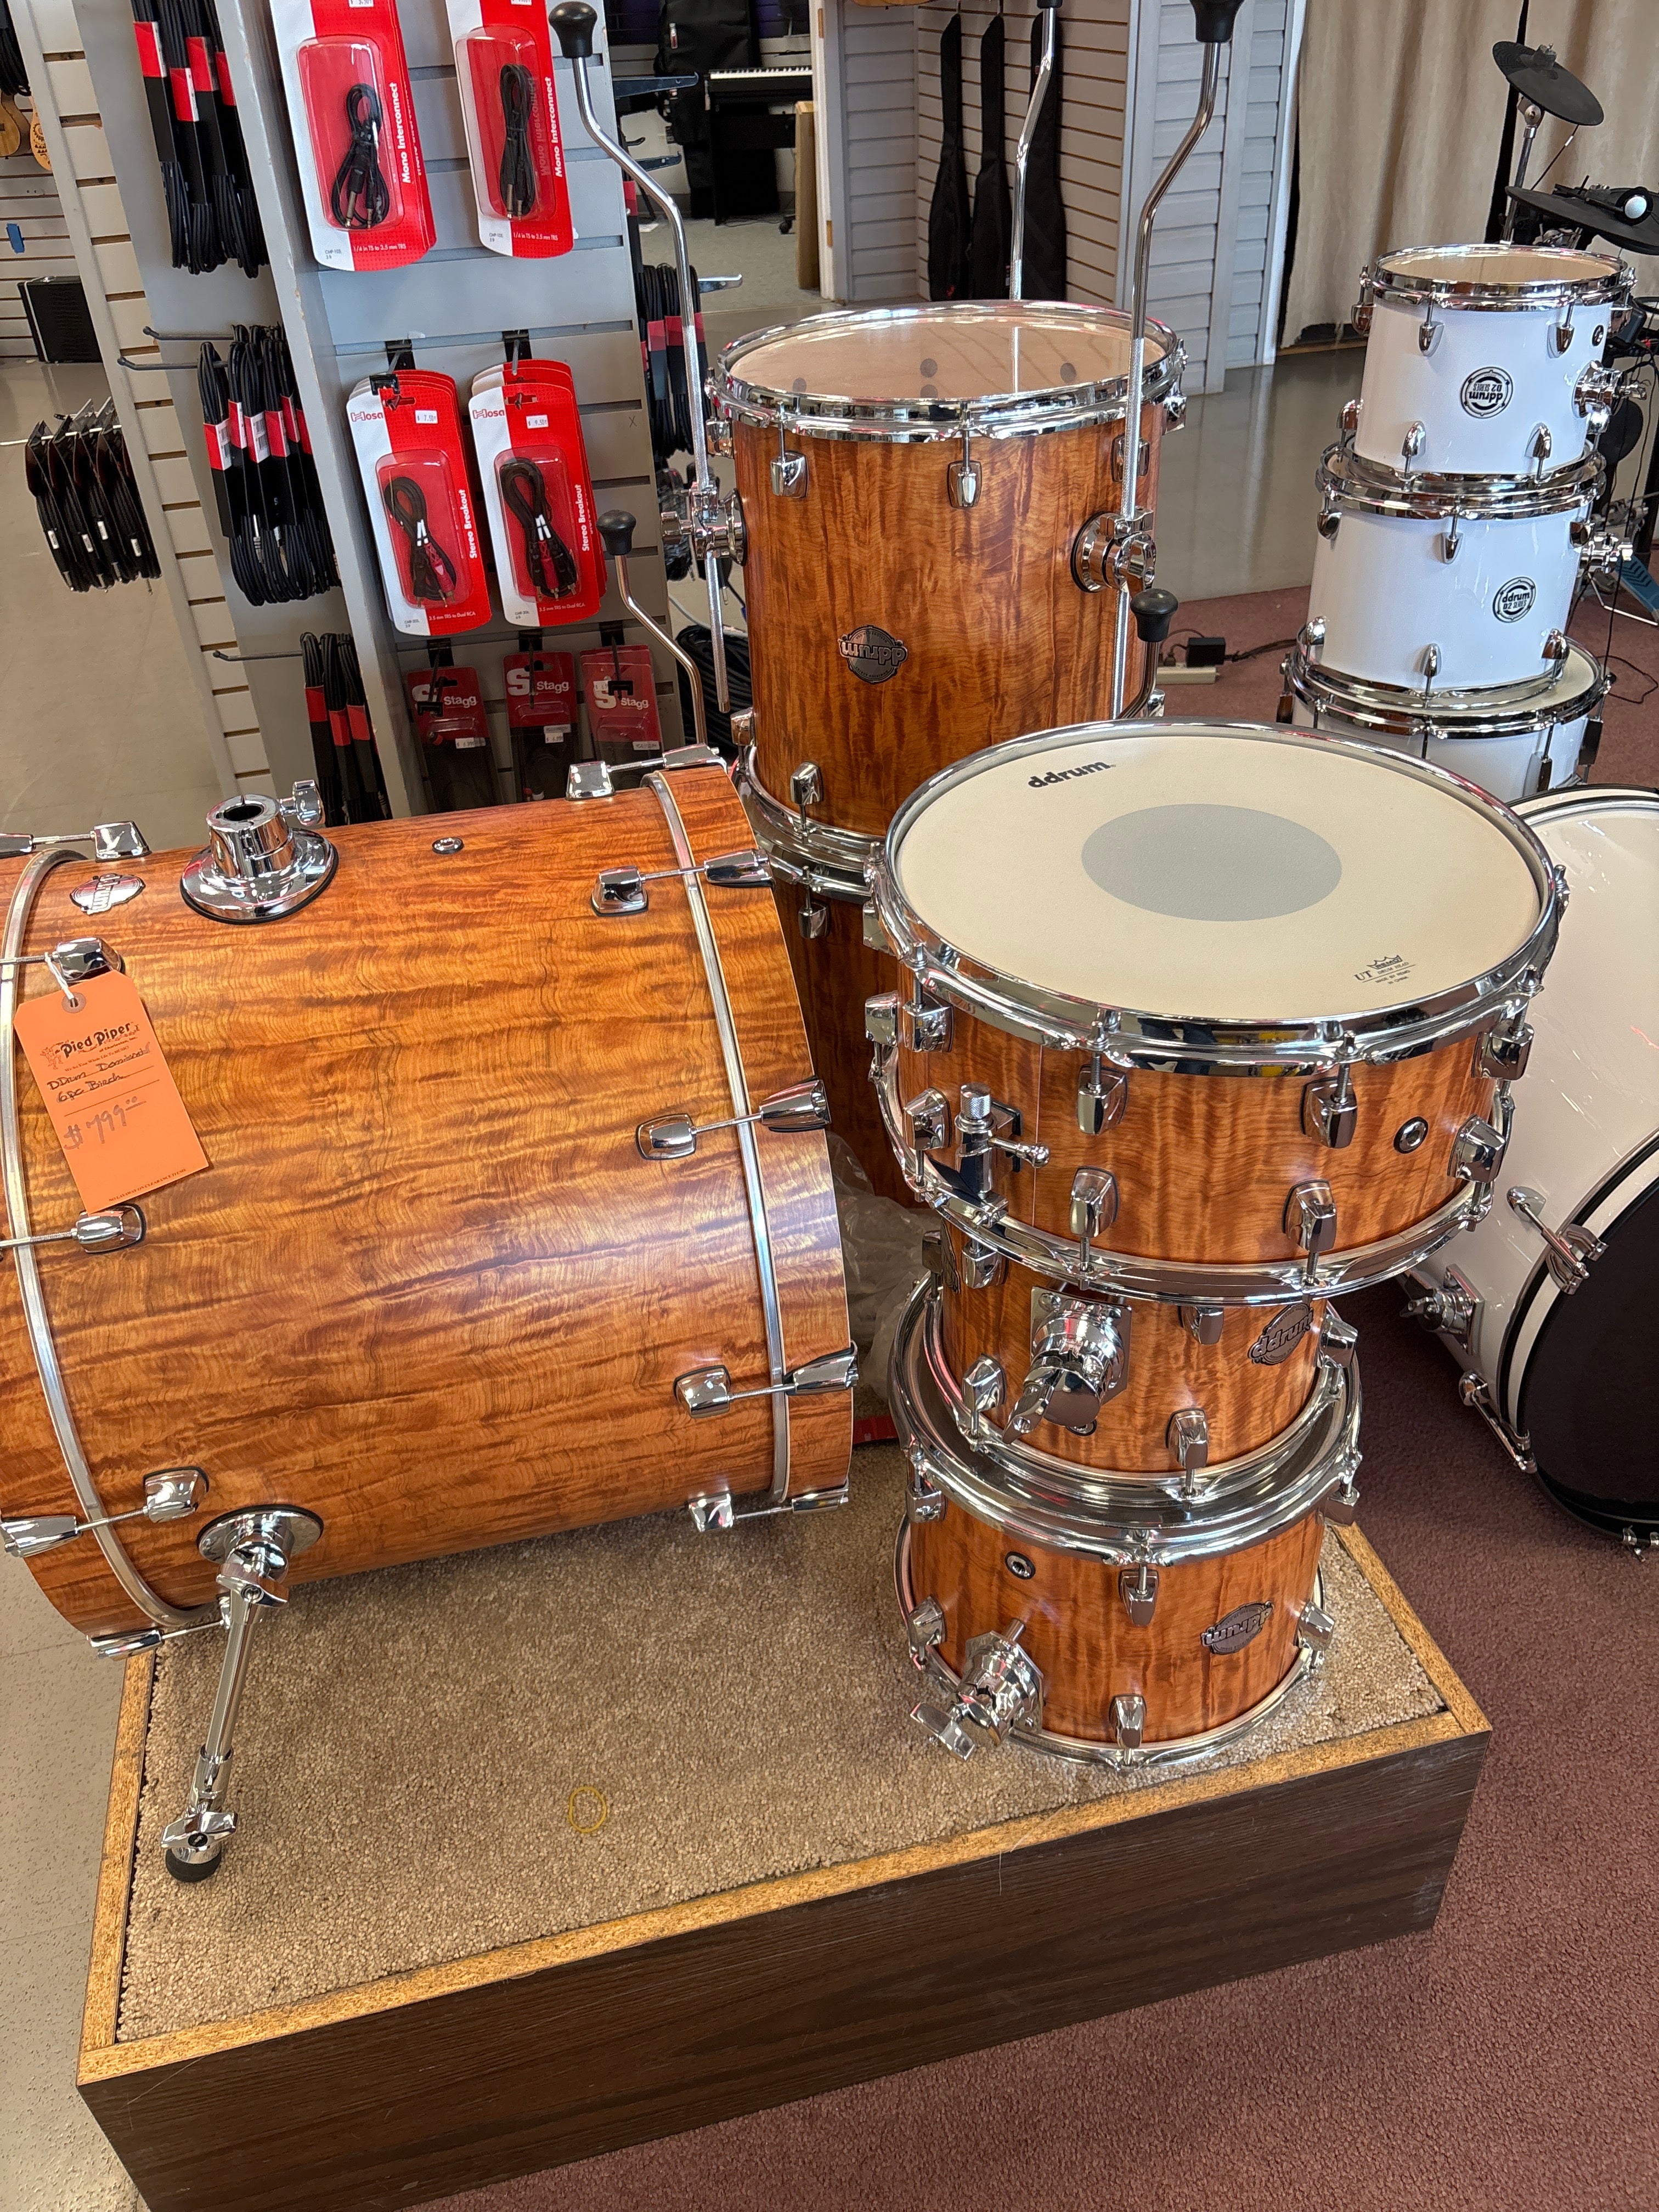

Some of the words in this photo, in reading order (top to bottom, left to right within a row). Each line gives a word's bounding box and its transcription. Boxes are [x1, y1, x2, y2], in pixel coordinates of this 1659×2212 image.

[389, 82, 406, 150] Interconnect
[544, 76, 558, 144] Interconnect
[401, 151, 411, 184] Mono
[554, 145, 563, 178] Mono
[1469, 391, 1503, 403] ddrum
[350, 411, 383, 422] Hosa
[472, 409, 505, 420] Hosa
[458, 489, 472, 530] Breakout
[574, 484, 586, 523] Breakout
[467, 531, 477, 558] Stereo
[581, 524, 590, 551] Stereo
[1502, 592, 1530, 603] ddrum
[841, 641, 906, 666] ddrum
[536, 680, 570, 694] Stagg
[443, 695, 477, 709] Stagg
[620, 697, 650, 710] Stagg
[1028, 761, 1111, 788] ddrum
[1353, 970, 1373, 981] UT
[1375, 958, 1400, 968] REMO
[60, 1035, 93, 1059] Pied
[93, 1022, 131, 1046] Piper
[1251, 1310, 1313, 1358] ddrum
